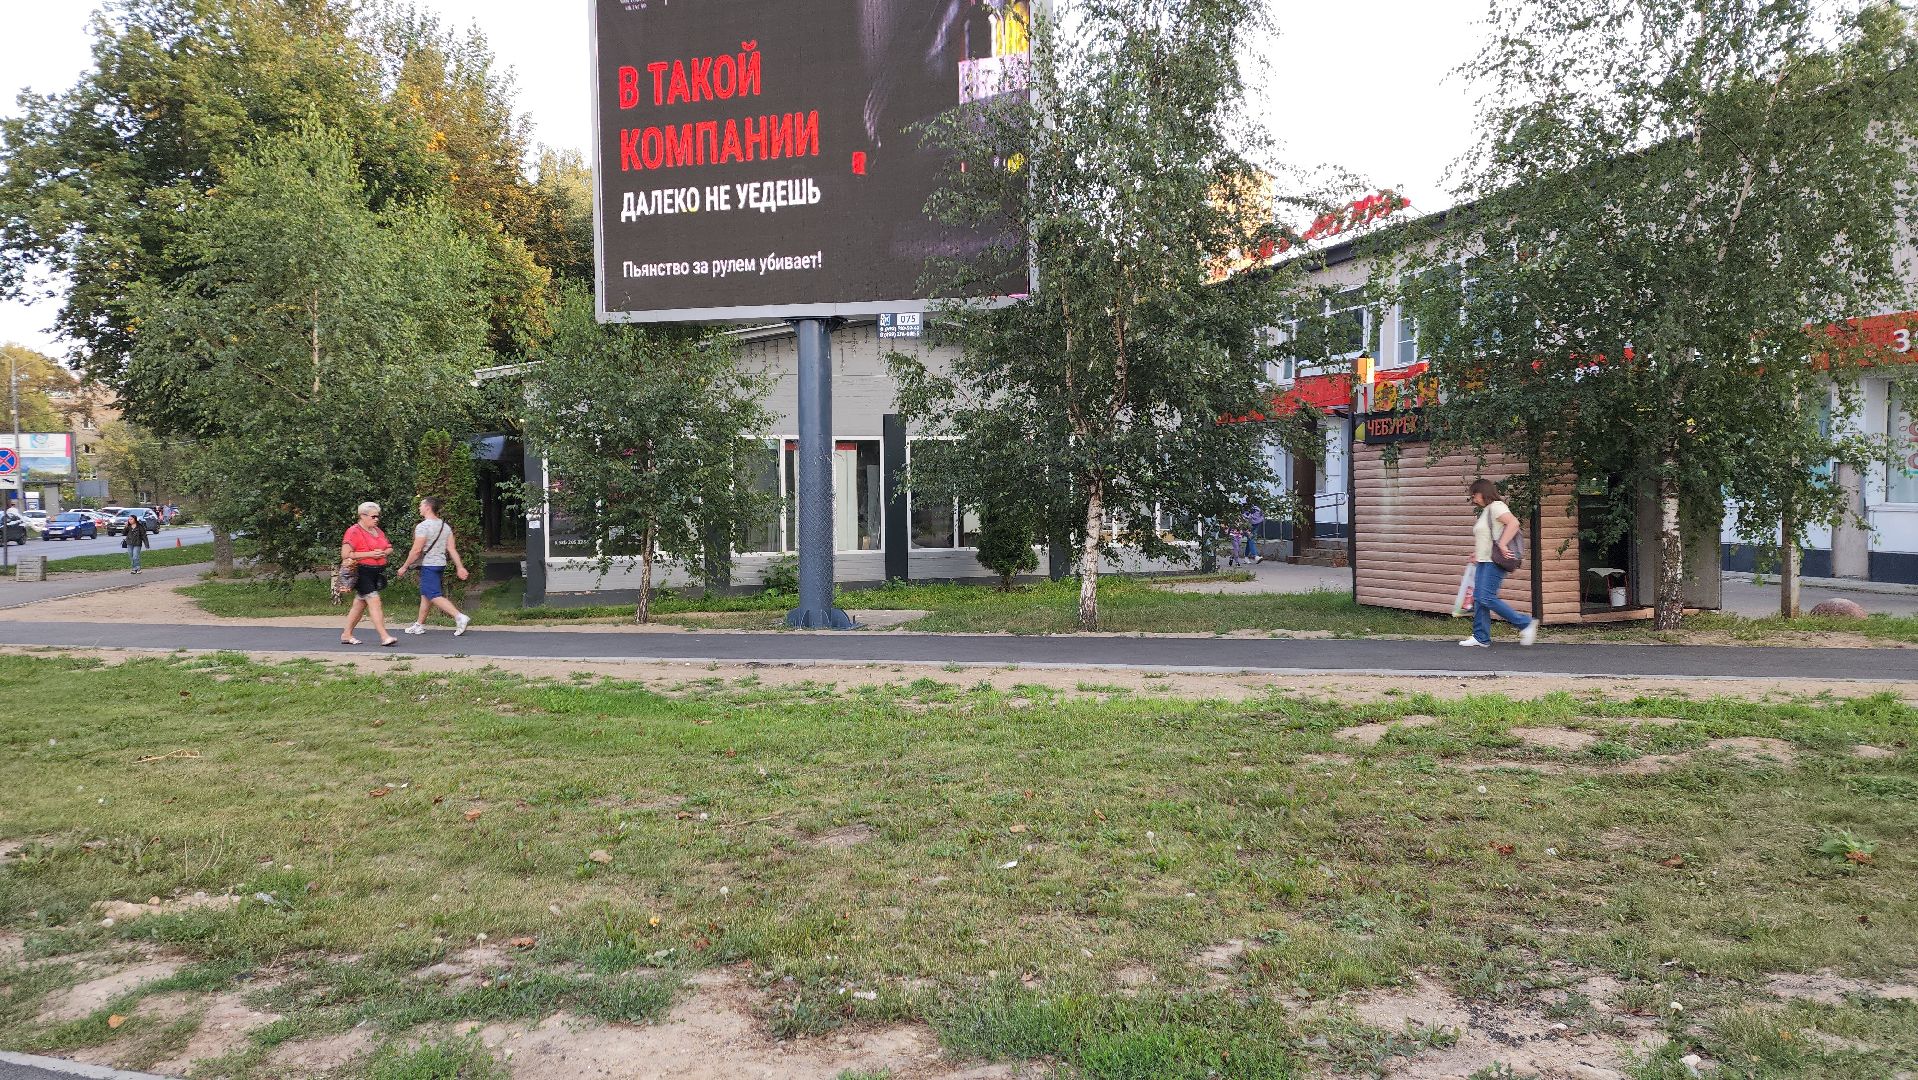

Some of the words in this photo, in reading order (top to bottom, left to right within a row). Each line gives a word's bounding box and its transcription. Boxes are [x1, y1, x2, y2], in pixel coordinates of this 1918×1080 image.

[618, 65, 640, 110] В
[647, 39, 761, 106] ТАКОЙ
[620, 110, 819, 172] КОМПАНИИ
[620, 186, 700, 222] ДАЛЕКО
[705, 185, 731, 211] НЕ
[736, 177, 821, 213] УЕДЕШЬ
[623, 260, 690, 278] Пьянство
[692, 260, 709, 275] за
[712, 257, 756, 277] рулем
[759, 250, 822, 275] убивает!
[900, 314, 916, 324] 075
